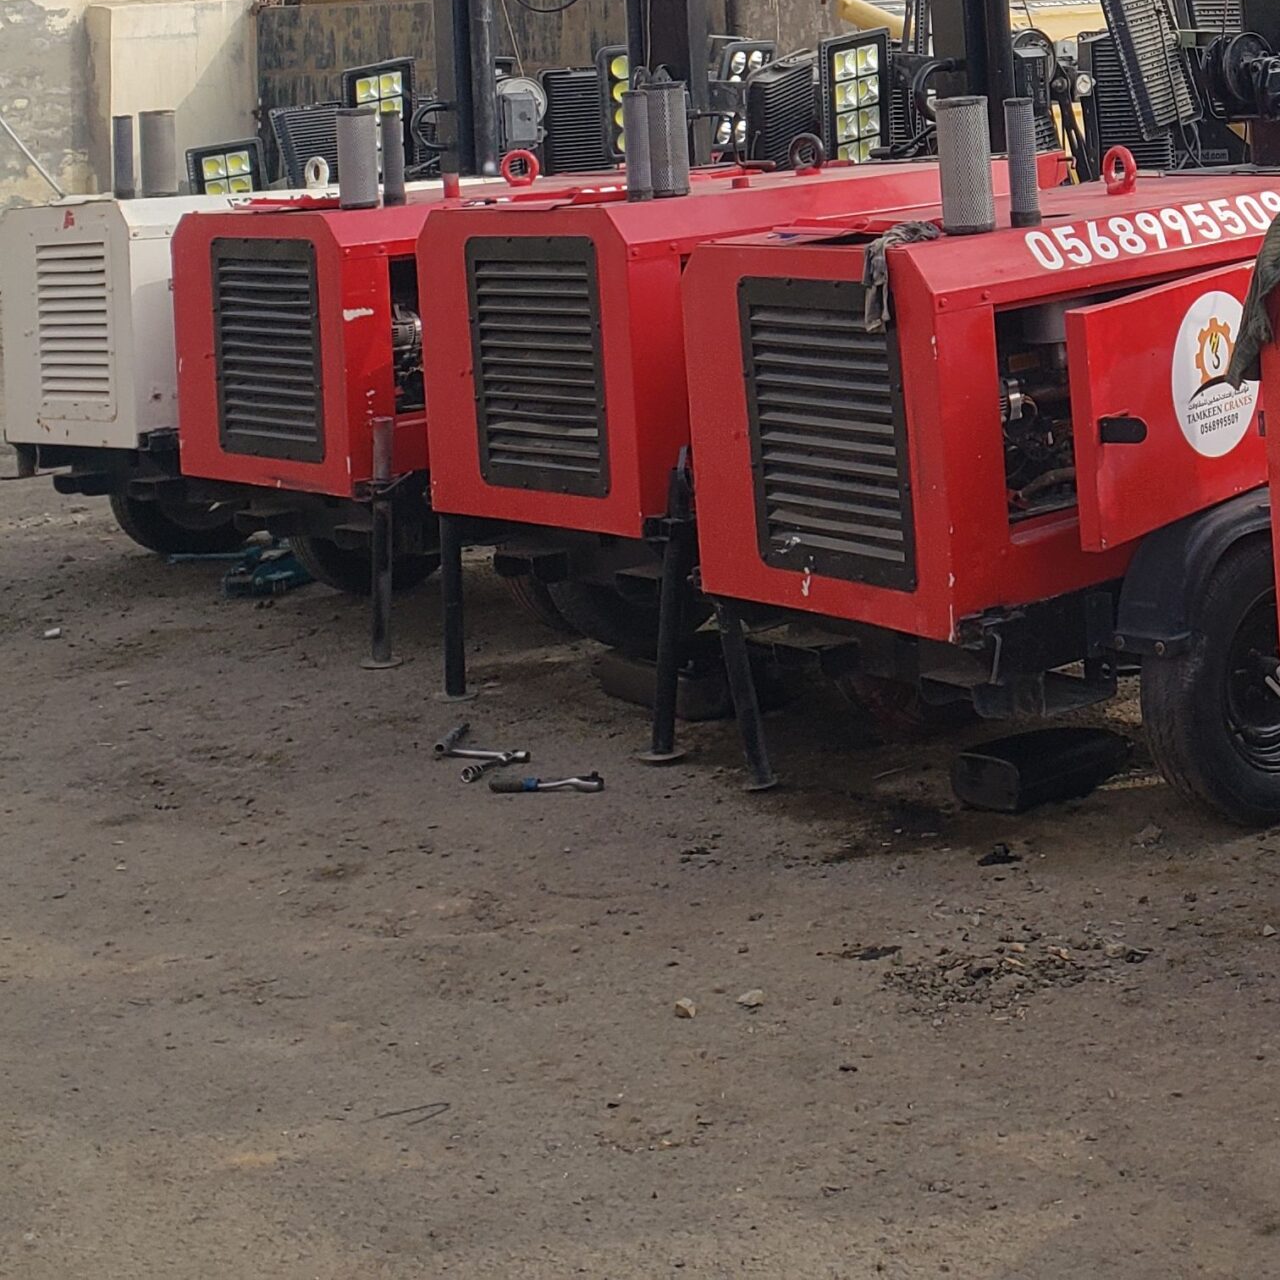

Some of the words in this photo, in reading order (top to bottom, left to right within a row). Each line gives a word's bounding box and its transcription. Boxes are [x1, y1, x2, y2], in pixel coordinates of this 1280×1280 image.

[1186, 404, 1223, 425] TAMKEEN
[1224, 394, 1253, 412] CRANES
[1200, 412, 1239, 435] 0568995509
